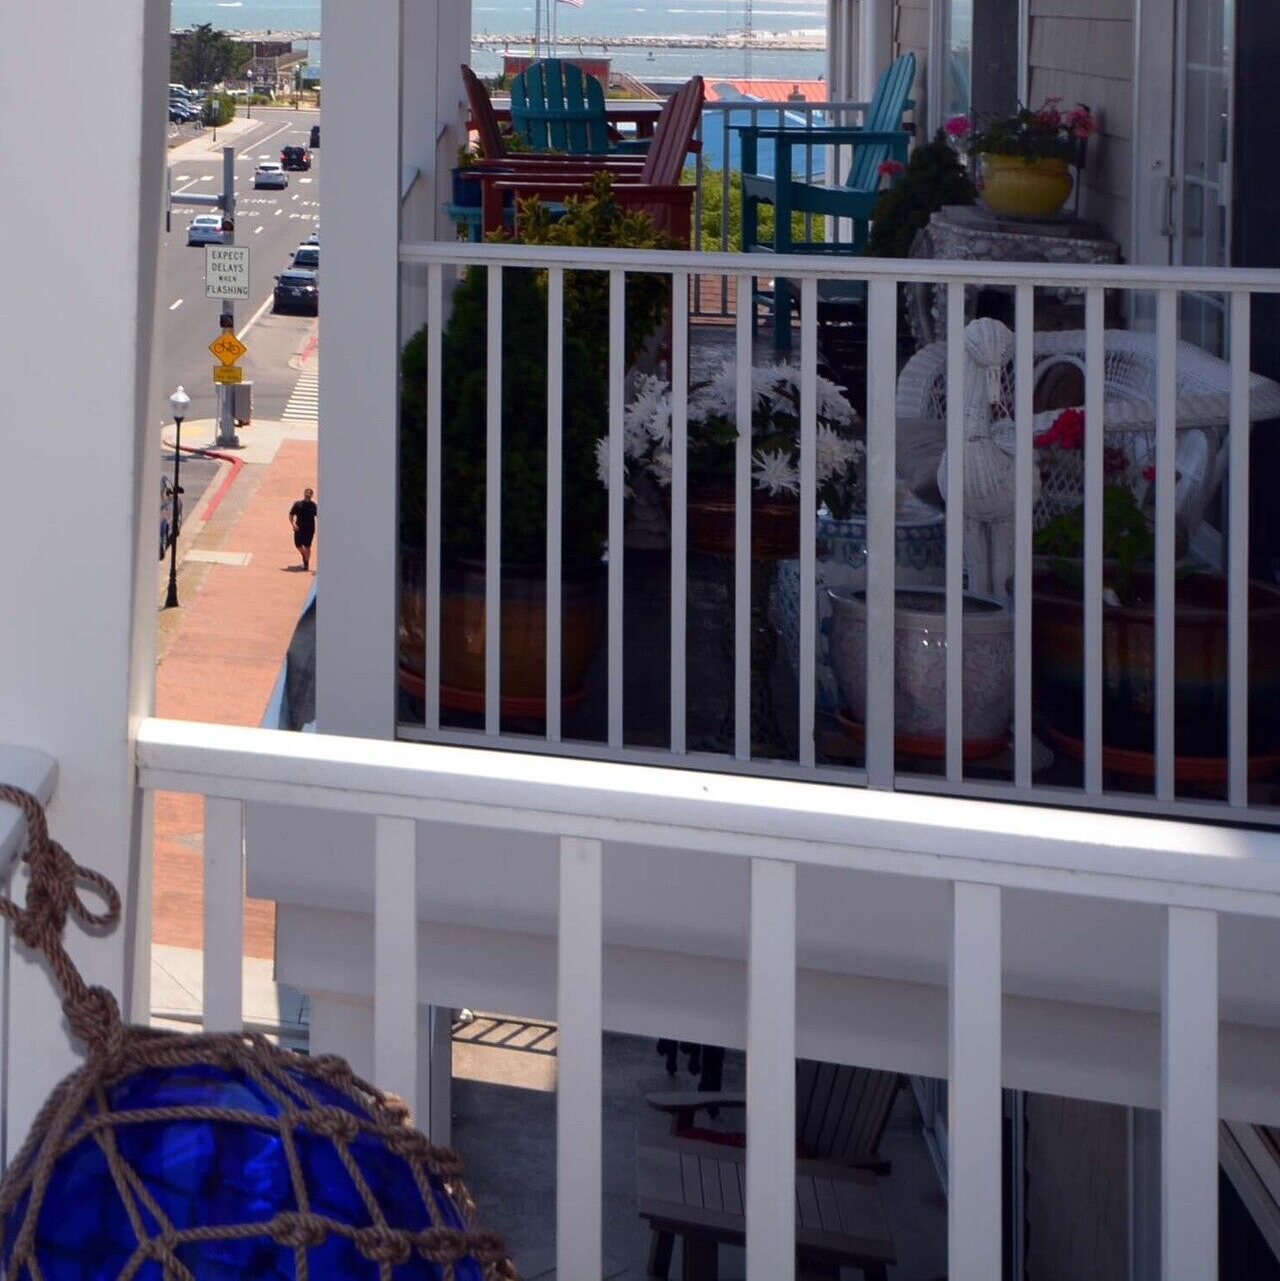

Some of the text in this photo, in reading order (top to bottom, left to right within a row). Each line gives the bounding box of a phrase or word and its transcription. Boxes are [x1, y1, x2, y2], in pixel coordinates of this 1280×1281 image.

[211, 250, 244, 260] EXPECT
[211, 262, 244, 273] DELAYS
[206, 285, 248, 295] FLASHING
